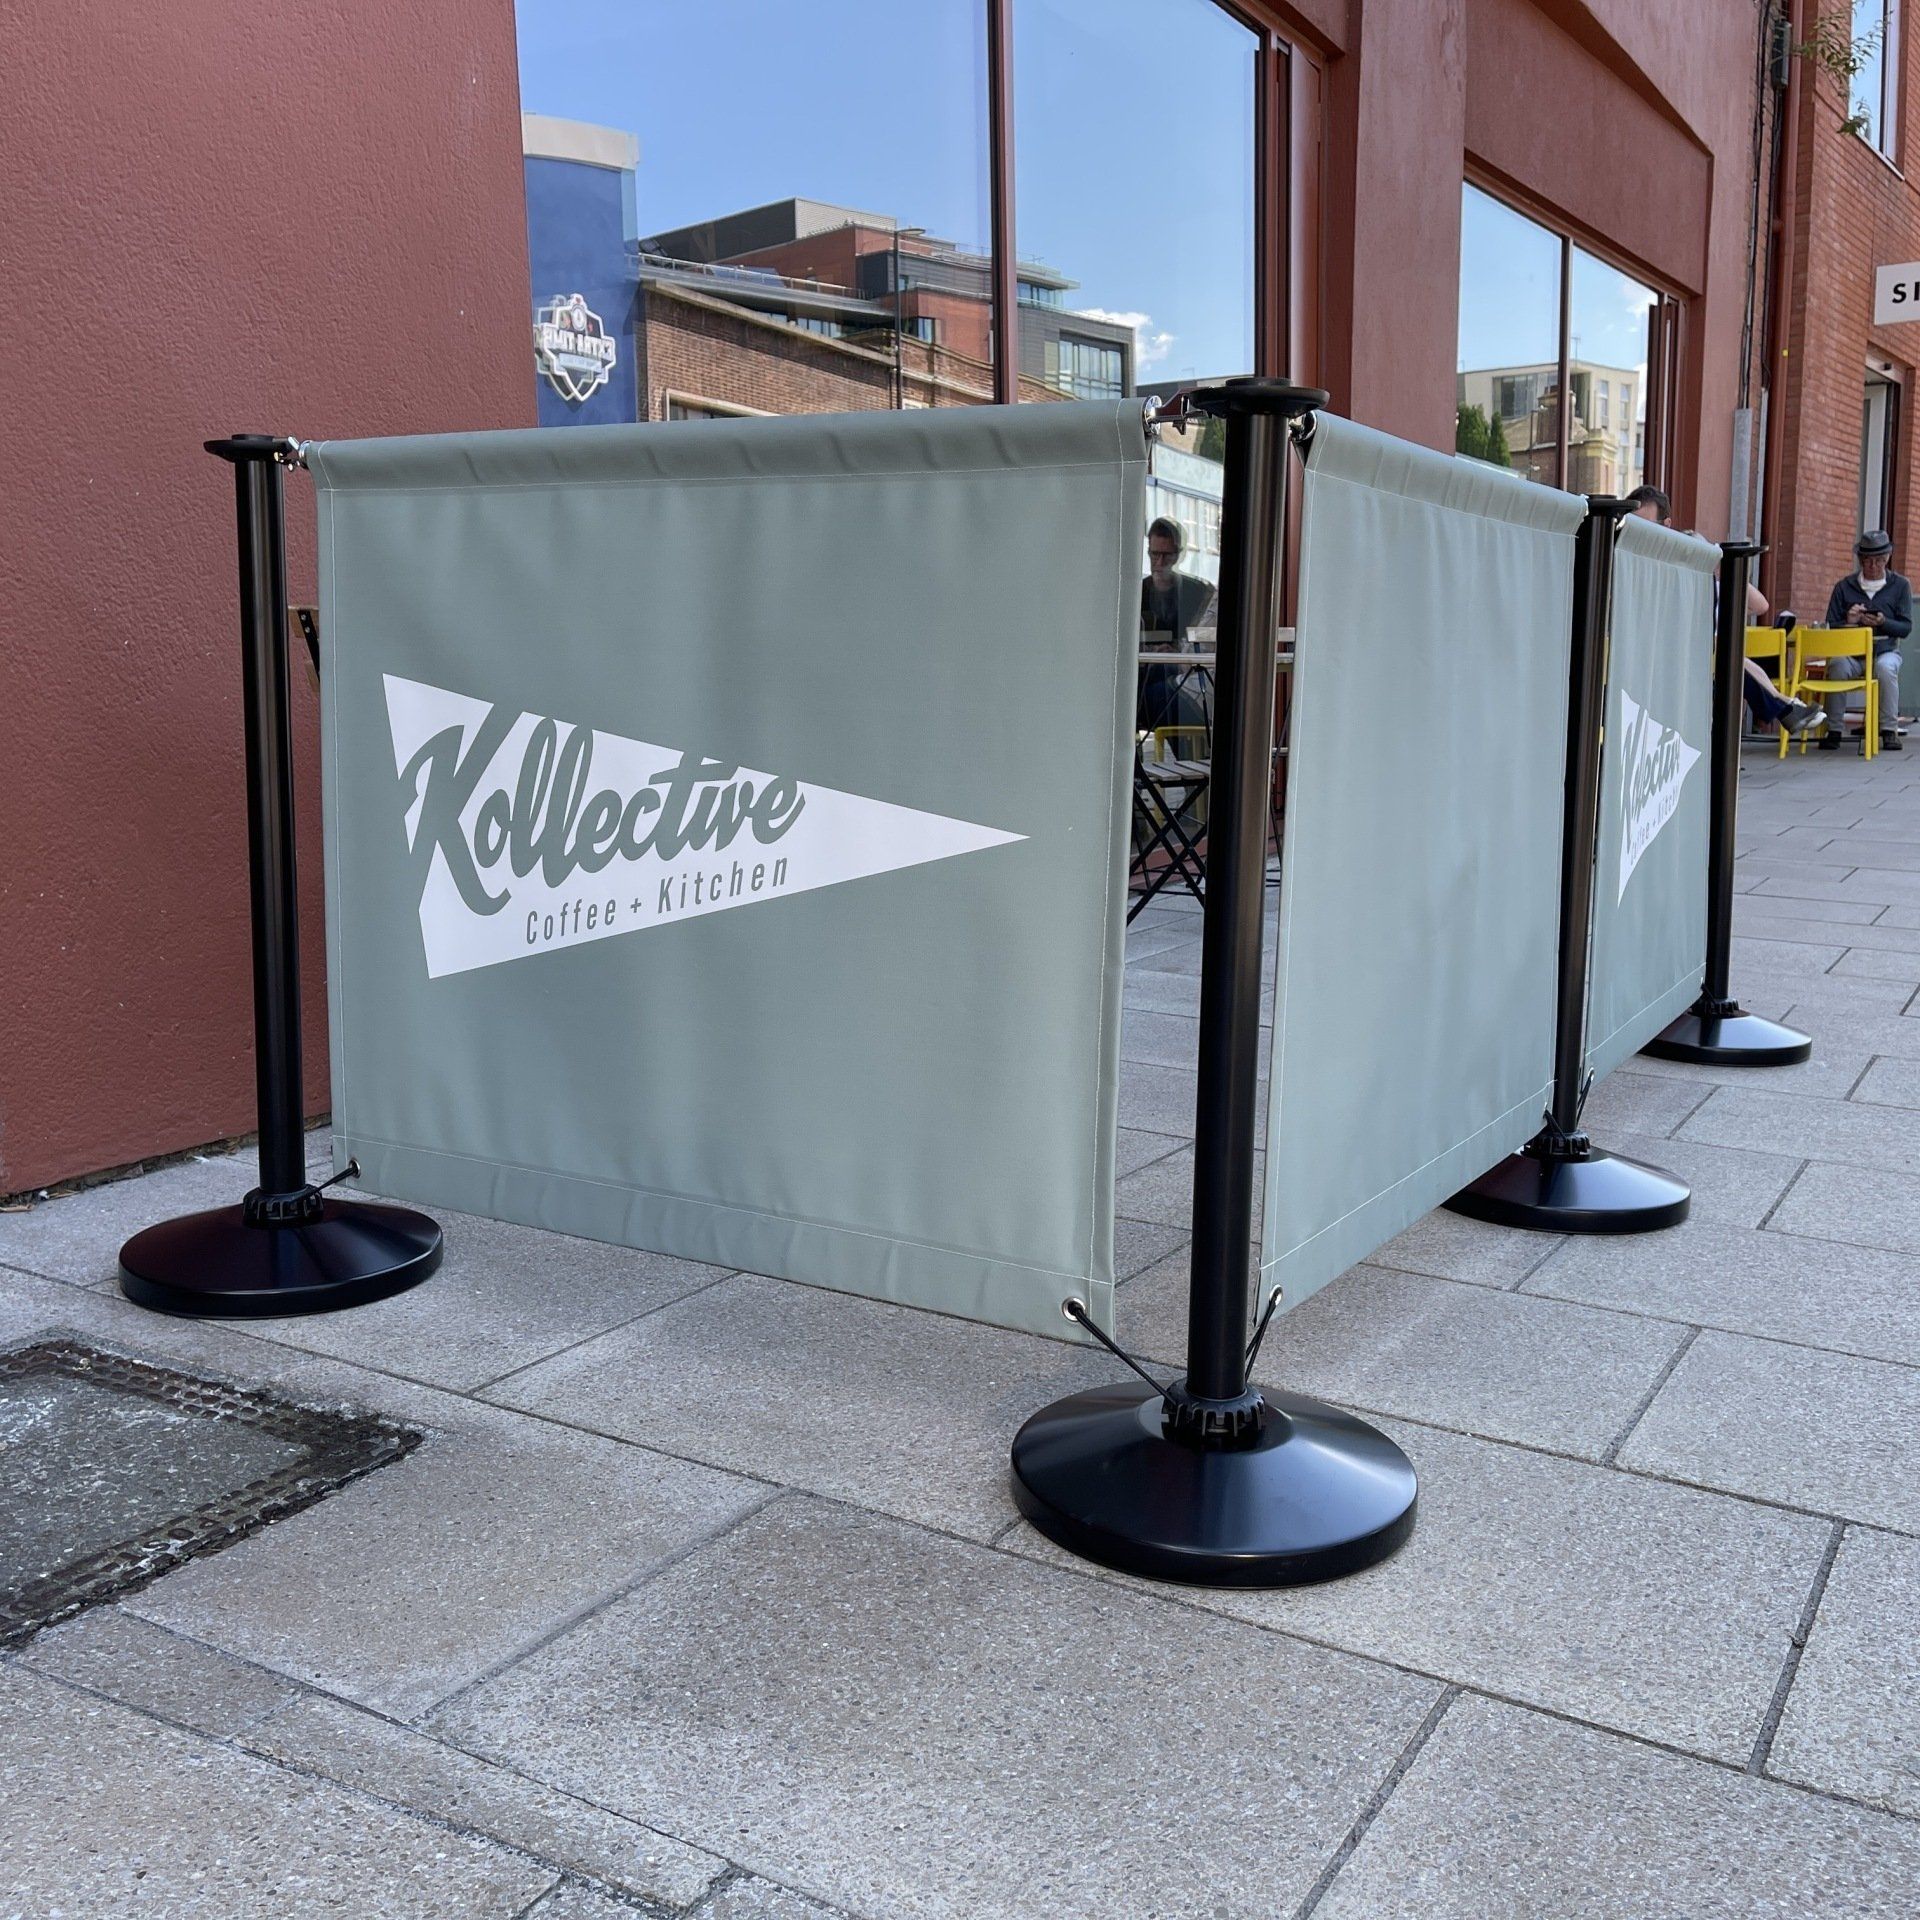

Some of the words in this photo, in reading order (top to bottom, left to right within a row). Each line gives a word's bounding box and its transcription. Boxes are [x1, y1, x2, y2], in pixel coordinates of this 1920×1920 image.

[398, 704, 806, 916] Kollective
[526, 899, 616, 944] Coffee
[630, 898, 642, 913] +
[657, 857, 788, 914] Kitchen
